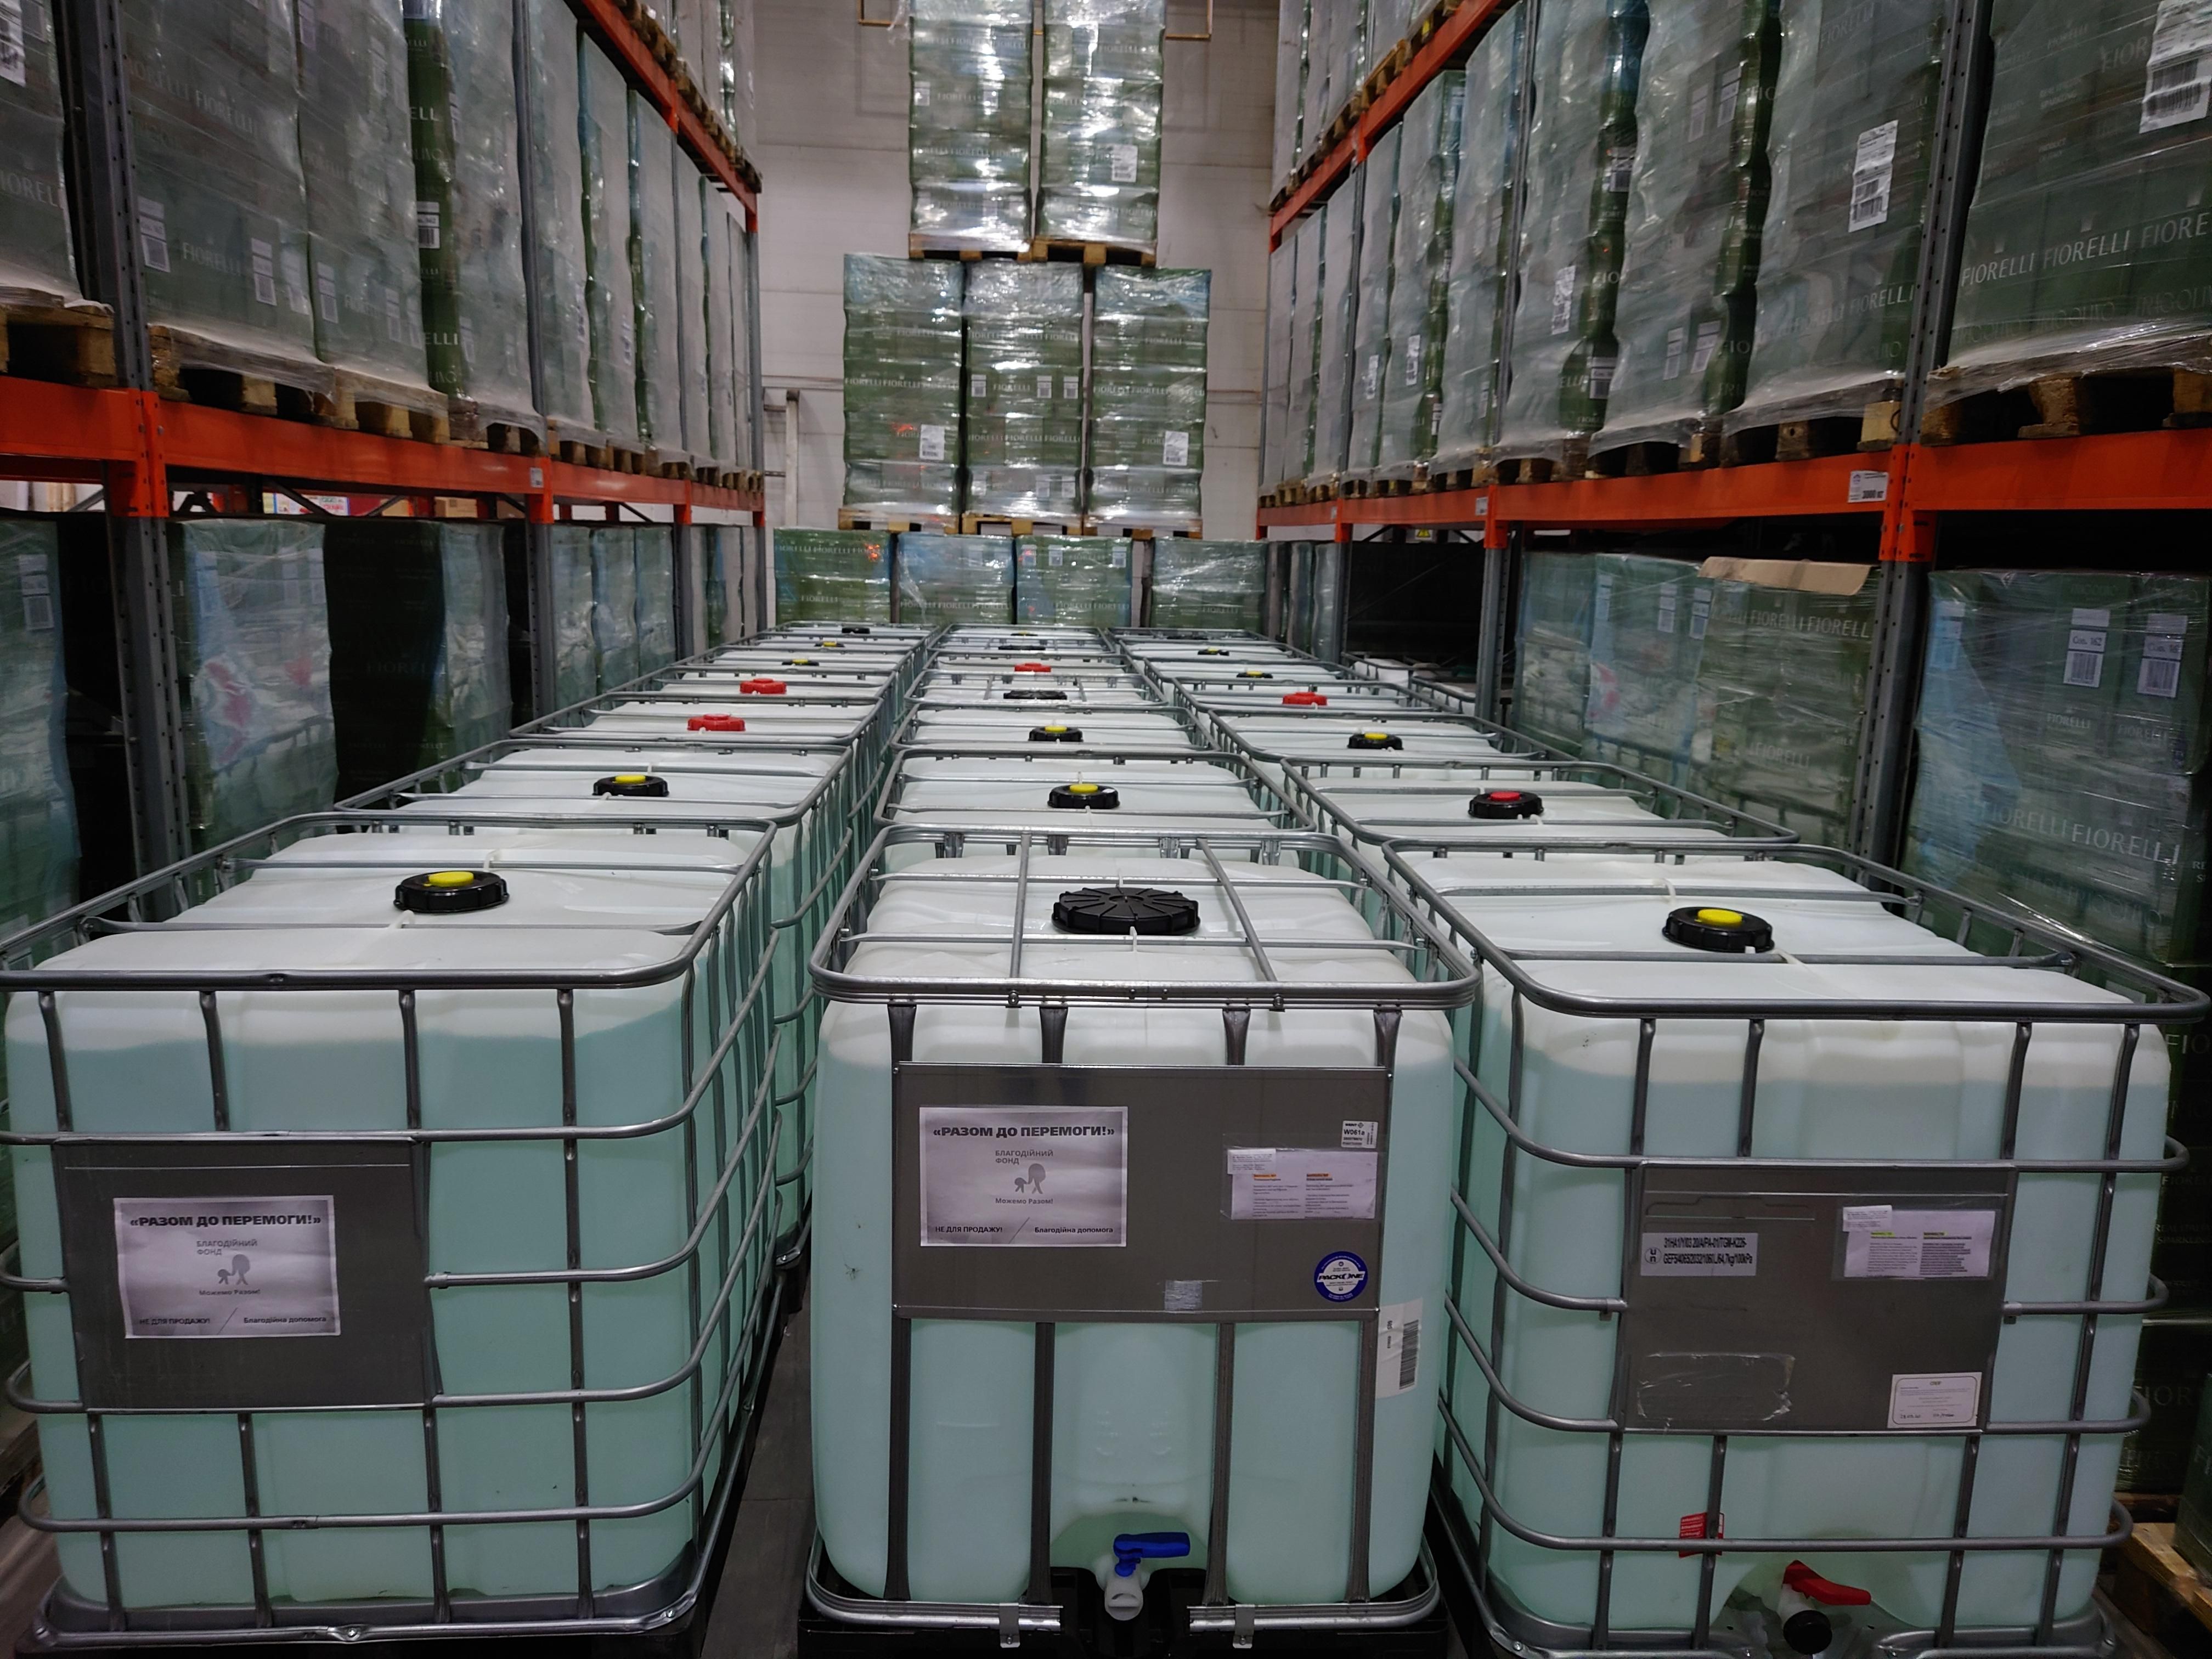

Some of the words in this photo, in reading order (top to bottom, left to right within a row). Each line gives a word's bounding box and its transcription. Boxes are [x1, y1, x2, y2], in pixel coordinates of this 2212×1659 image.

[2043, 230, 2131, 269] FIORELLI
[1961, 253, 2035, 286] FIORELLI
[1850, 285, 1915, 315] FIORELLI
[2071, 822, 2181, 866] FIORELLI
[933, 1127, 993, 1137] «РАЗОМ
[996, 1127, 1018, 1138] ДО
[1020, 1126, 1115, 1137] ПЕРЕМОГИ!»
[995, 1149, 1054, 1158] БЛАГОДІЙНИЙ
[130, 1216, 193, 1227] «РАЗОМ
[196, 1216, 219, 1228] ДО
[222, 1214, 321, 1226] ПЕРЕМОГИ!»
[196, 1239, 258, 1248] БЛАГОДІЙНИЙ
[151, 1318, 167, 1326] ДЛЯ
